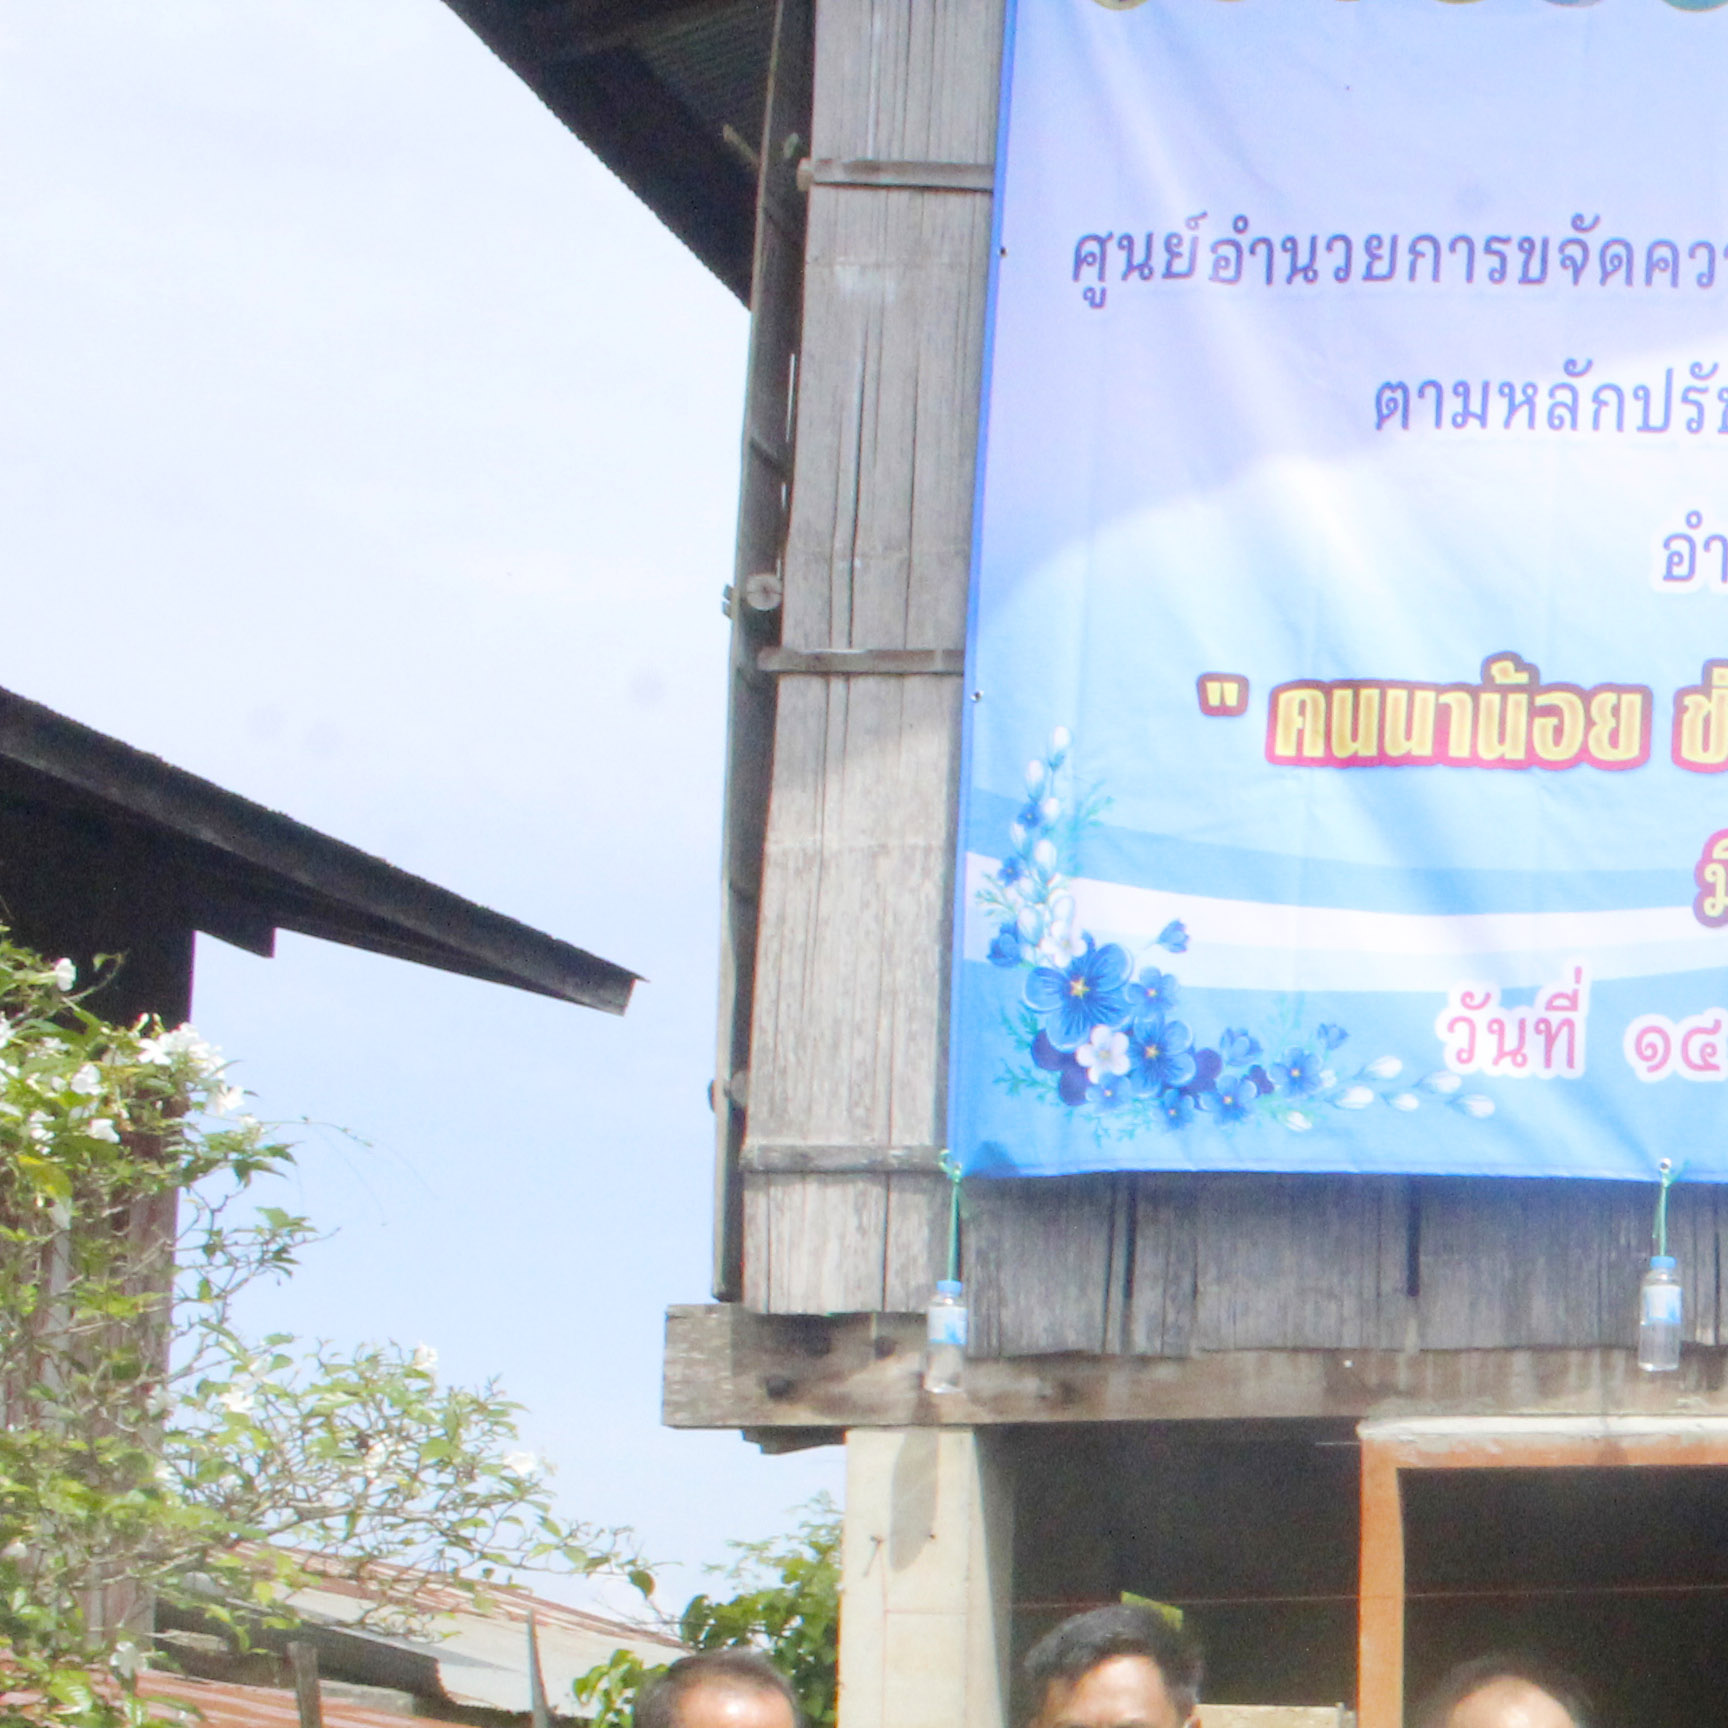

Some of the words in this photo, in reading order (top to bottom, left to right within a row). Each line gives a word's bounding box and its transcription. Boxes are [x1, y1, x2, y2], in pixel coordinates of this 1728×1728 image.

[1273, 659, 1642, 761] คนนาน้อย
[1446, 966, 1584, 1070] วันที่
[1632, 1016, 1725, 1072] ๑๔
